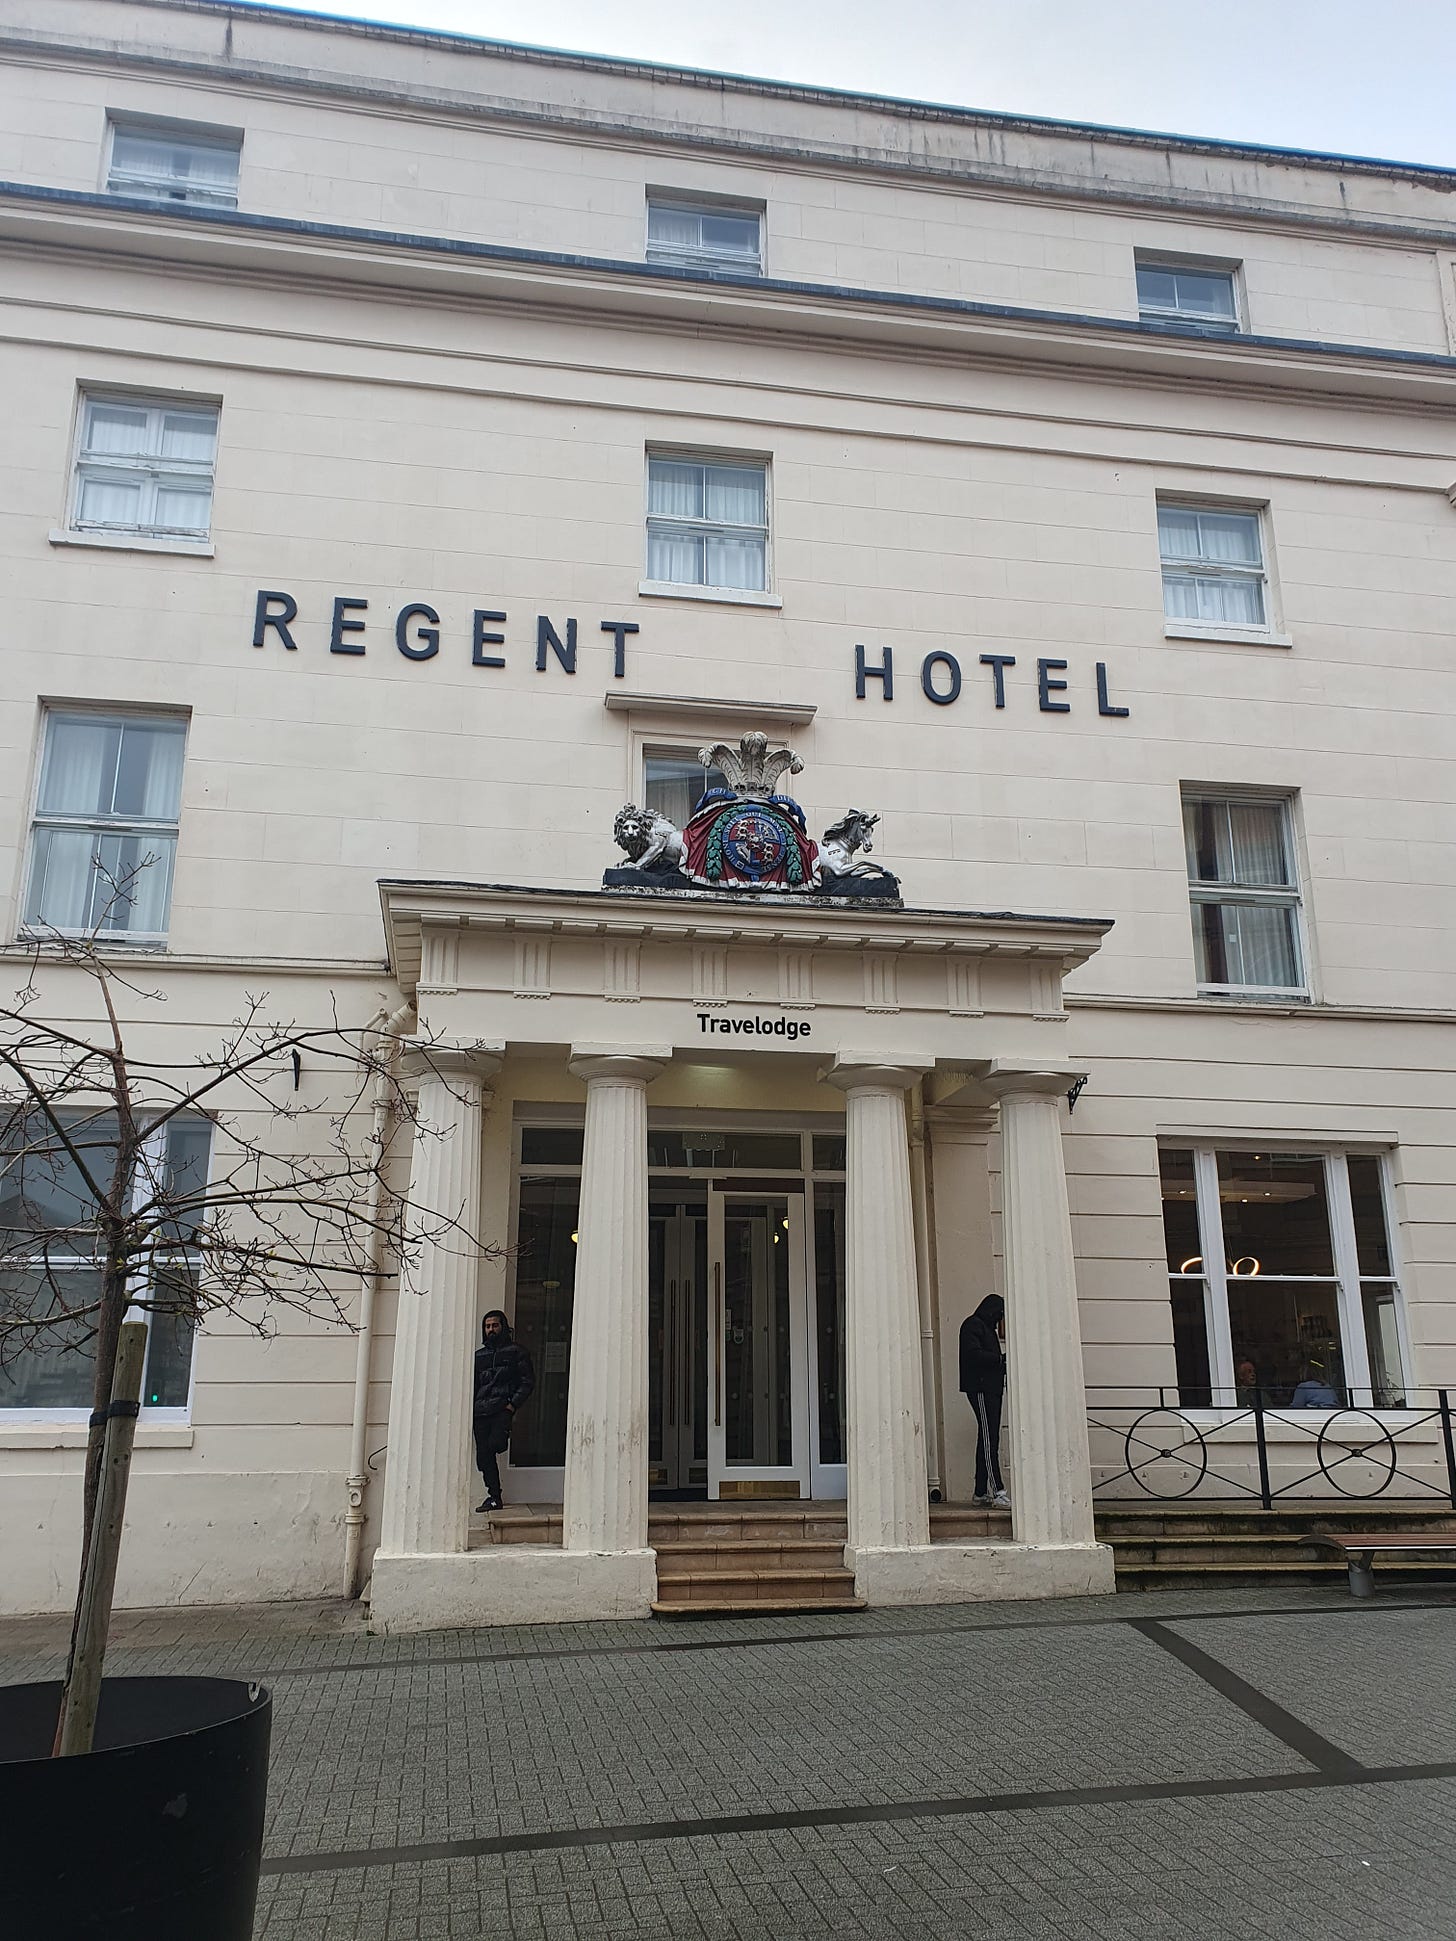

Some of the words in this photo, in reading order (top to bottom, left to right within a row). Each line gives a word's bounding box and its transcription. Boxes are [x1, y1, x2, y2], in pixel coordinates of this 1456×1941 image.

[252, 589, 640, 678] REGENT
[855, 644, 1130, 718] HOTEL
[697, 1013, 811, 1040] Travelodge
